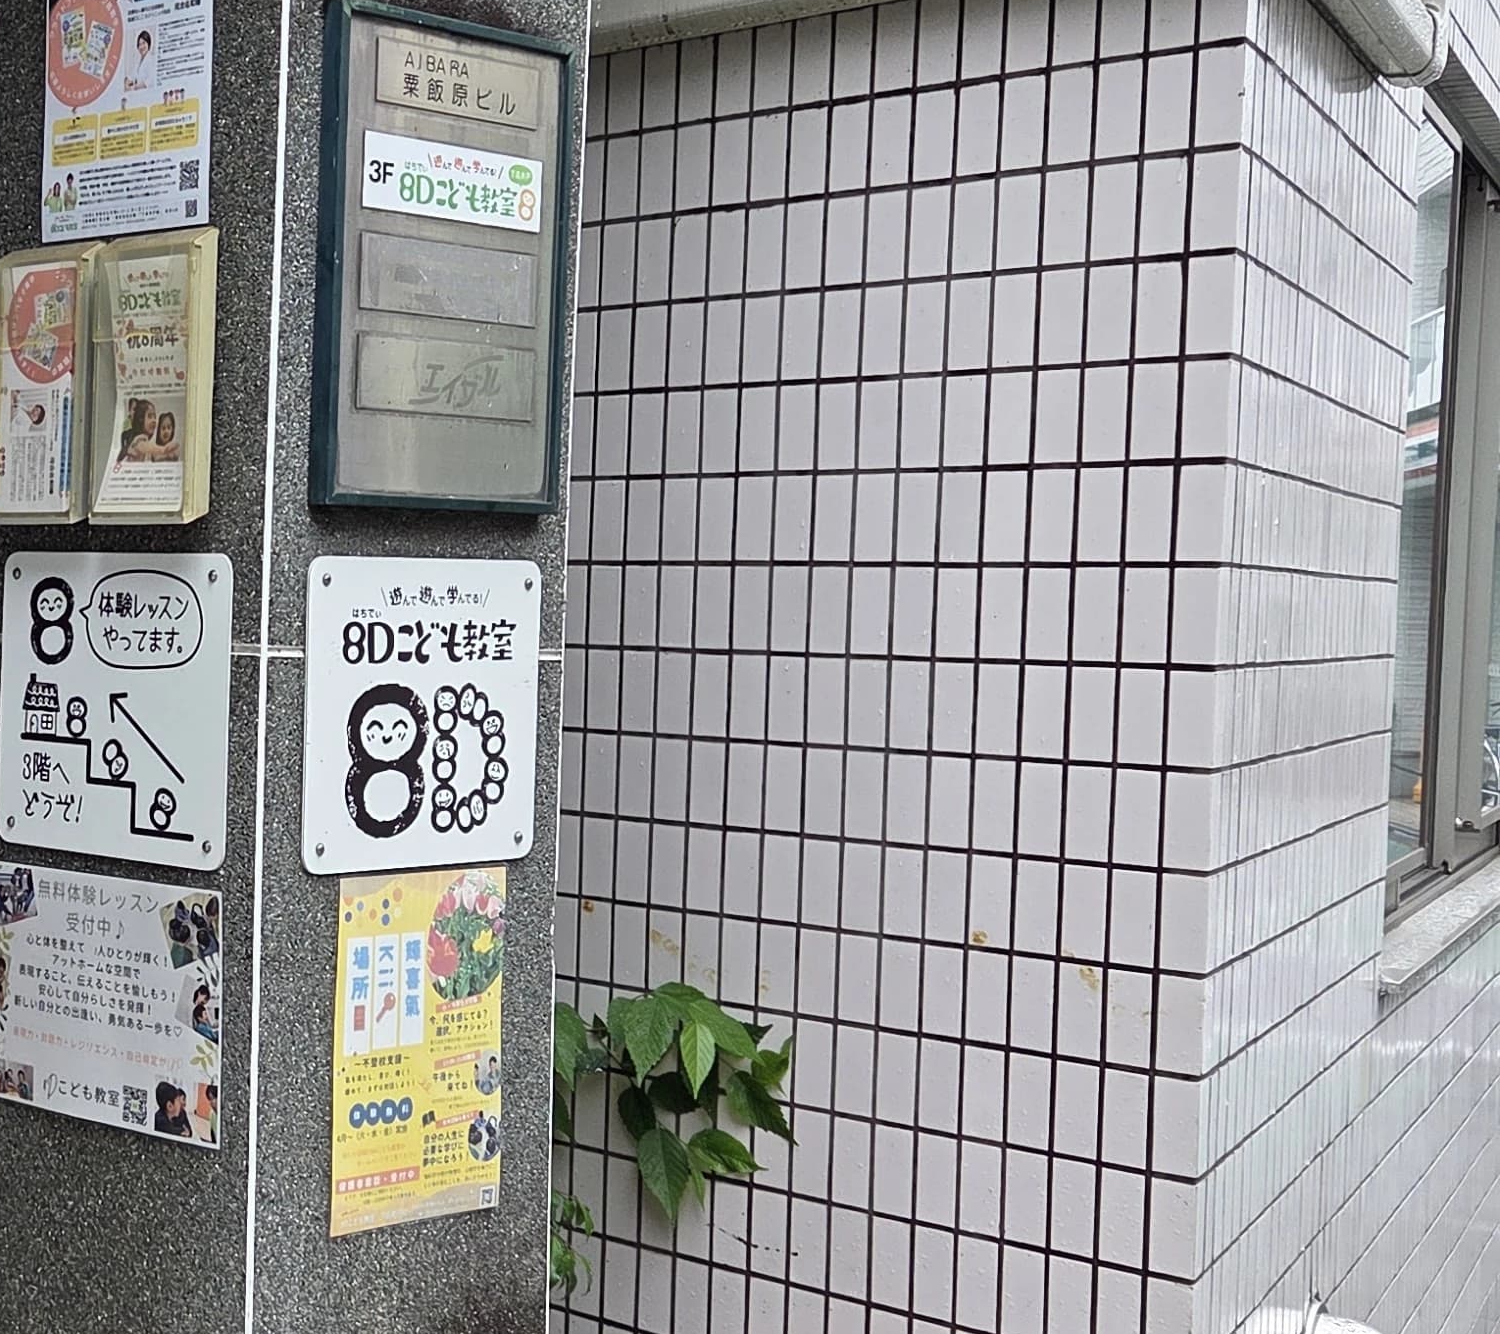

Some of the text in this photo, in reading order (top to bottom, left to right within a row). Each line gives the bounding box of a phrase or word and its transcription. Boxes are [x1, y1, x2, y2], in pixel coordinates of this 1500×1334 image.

[403, 72, 516, 116] 粟飯原ビル
[369, 160, 394, 184] 3F
[399, 171, 517, 218] 8Dこども教室
[98, 592, 189, 621] 体験レッスン
[103, 625, 183, 654] やってます。
[342, 619, 517, 665] 8Dこども教室
[22, 752, 71, 784] 3階へ
[37, 878, 160, 915] 無料体験レッスン
[26, 933, 85, 954] 心と体を整えて
